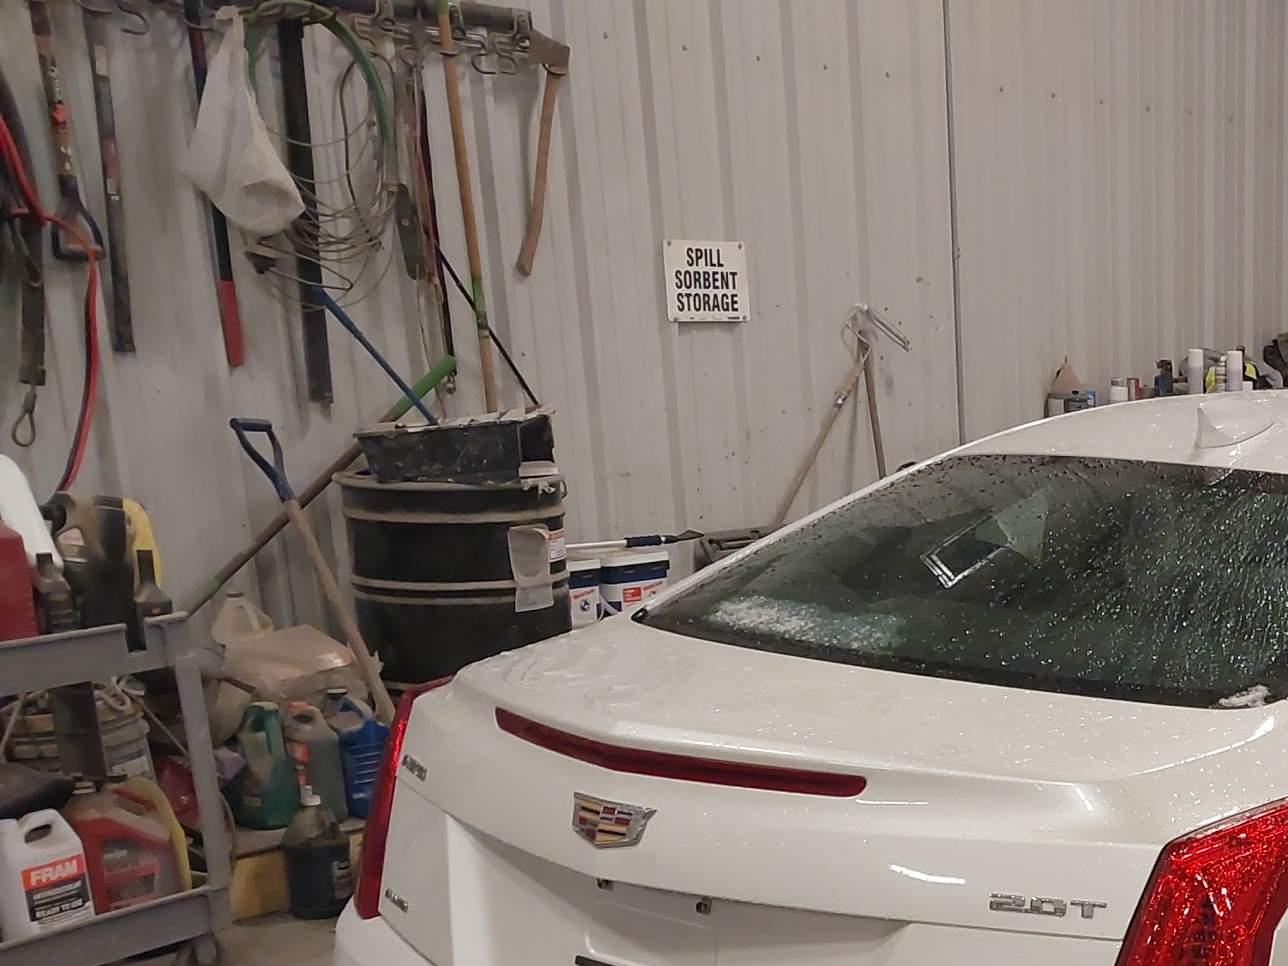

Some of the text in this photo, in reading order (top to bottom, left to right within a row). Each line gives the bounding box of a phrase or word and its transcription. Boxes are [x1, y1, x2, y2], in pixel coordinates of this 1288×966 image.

[686, 247, 724, 267] SPILL
[675, 270, 738, 290] SORBENT
[677, 293, 739, 312] STORAGE
[30, 859, 78, 886] FRAM
